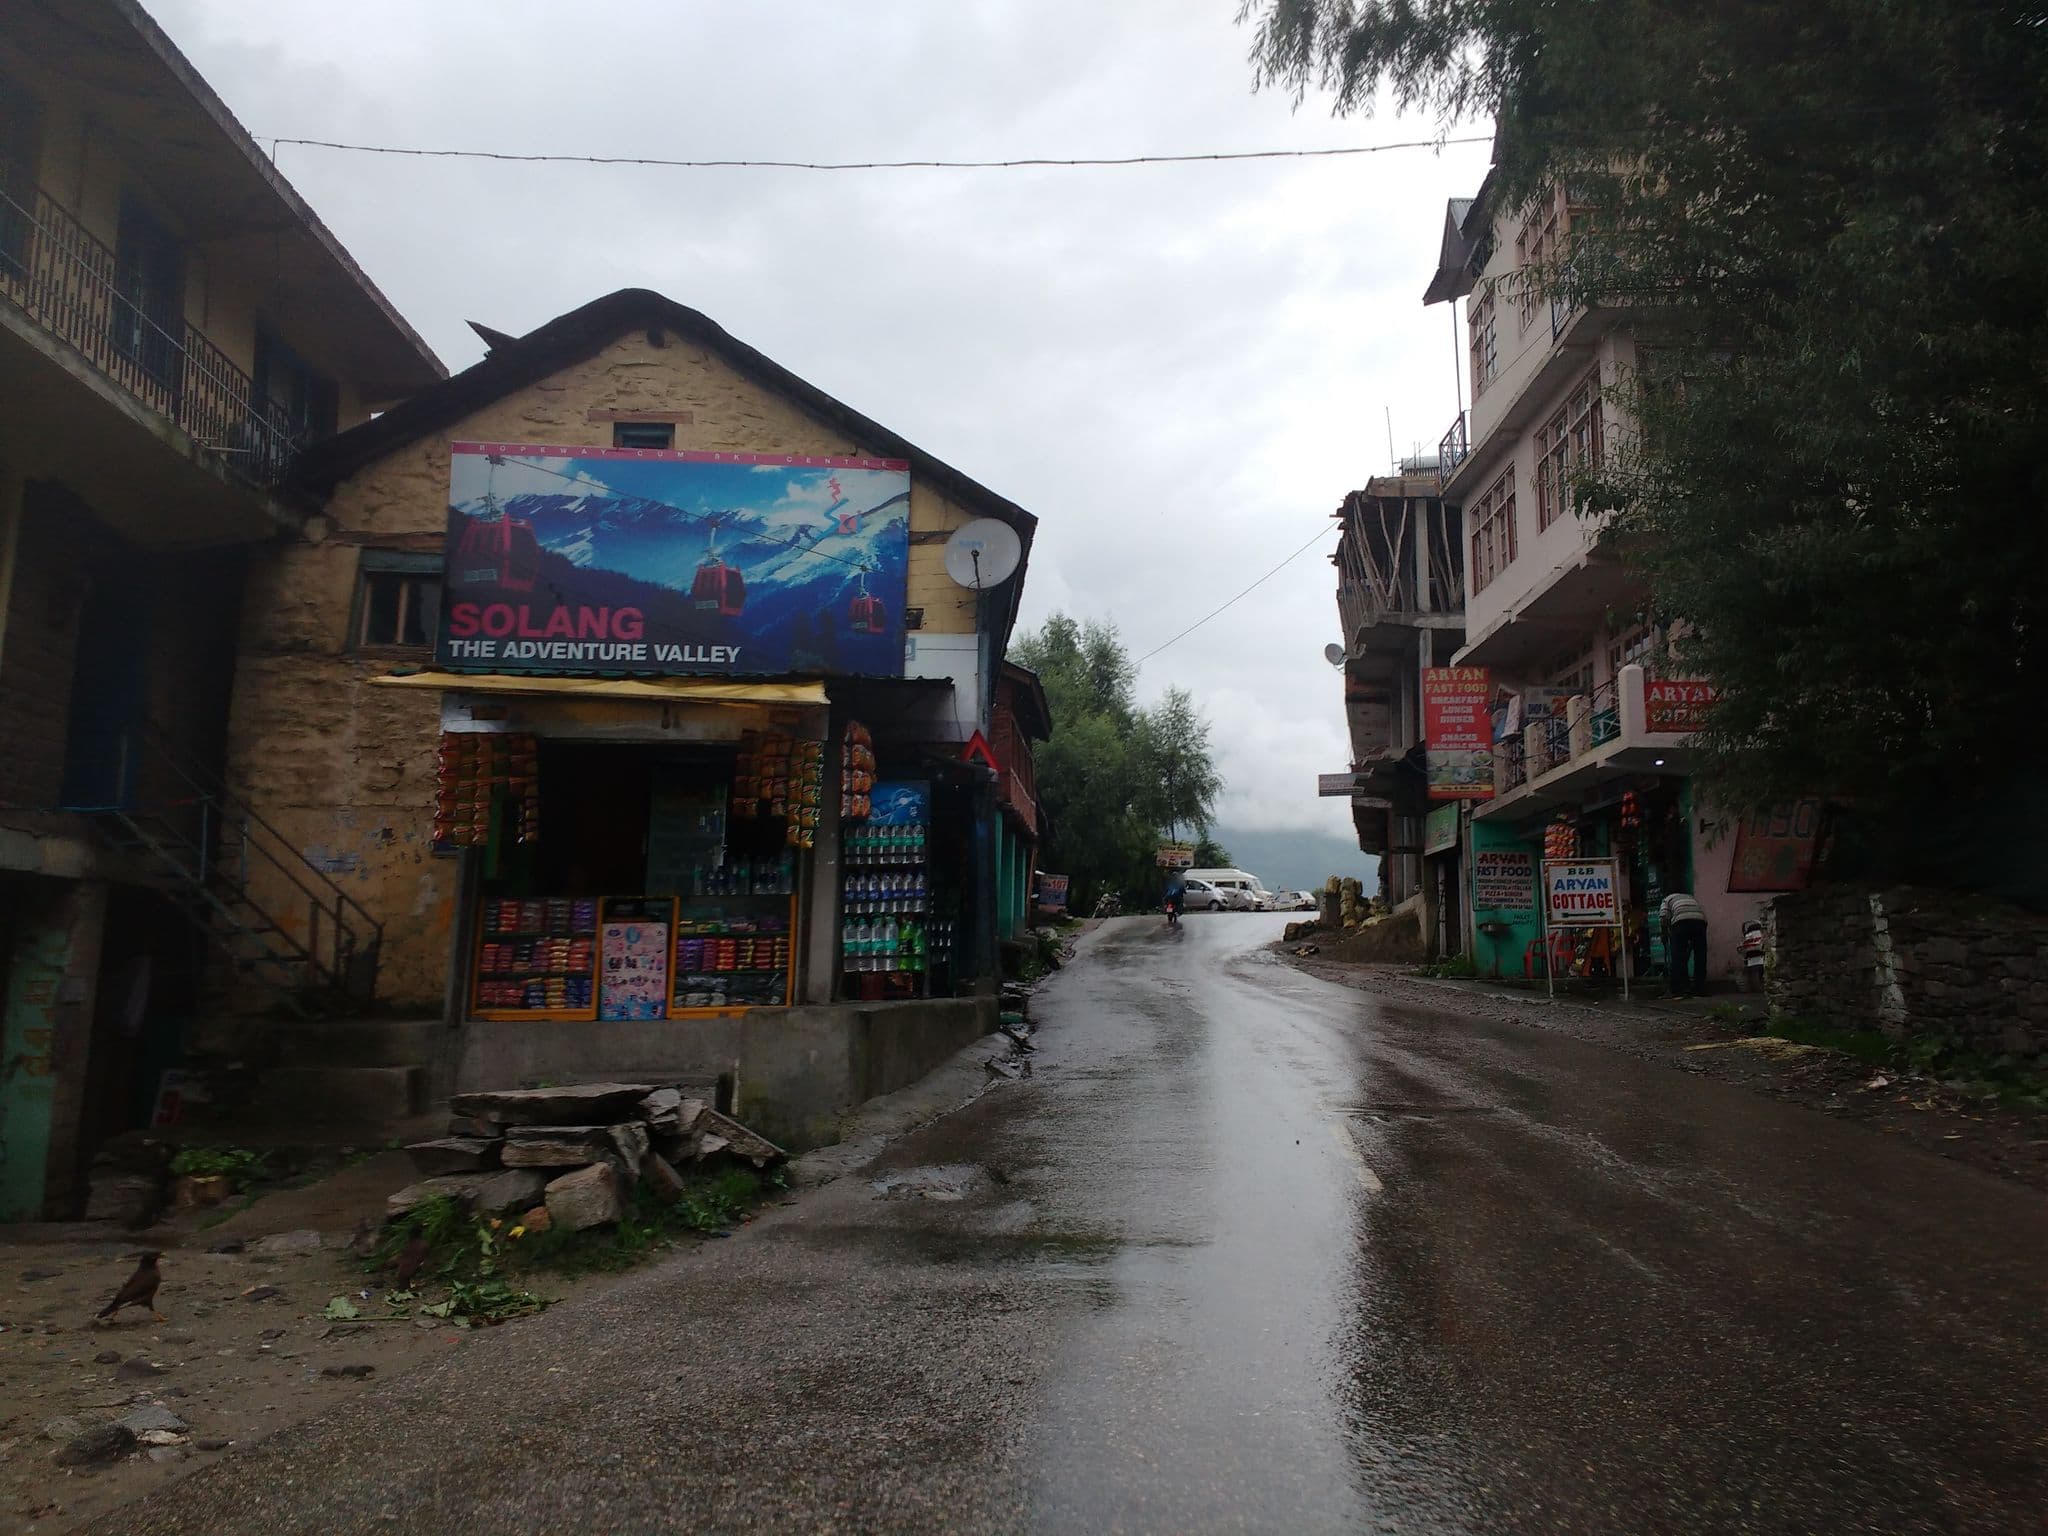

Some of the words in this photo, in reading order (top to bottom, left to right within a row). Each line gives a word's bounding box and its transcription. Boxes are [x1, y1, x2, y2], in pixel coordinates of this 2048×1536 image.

[479, 445, 607, 456] ROPEWAY
[637, 449, 684, 459] CUM
[714, 453, 757, 462] SKI
[786, 456, 887, 468] CENTRE
[450, 603, 645, 641] SOLANG
[448, 639, 496, 658] THE
[502, 641, 647, 661] ADVENTURE
[653, 644, 741, 663] VALLEY
[1427, 669, 1484, 681] ARYAN
[1425, 684, 1453, 694] FAST
[1457, 683, 1488, 693] FOOD
[1477, 866, 1498, 877] FAST
[1501, 866, 1532, 877] FOOD
[1554, 878, 1609, 890] ARYAN
[1552, 893, 1613, 909] COTTAGE
